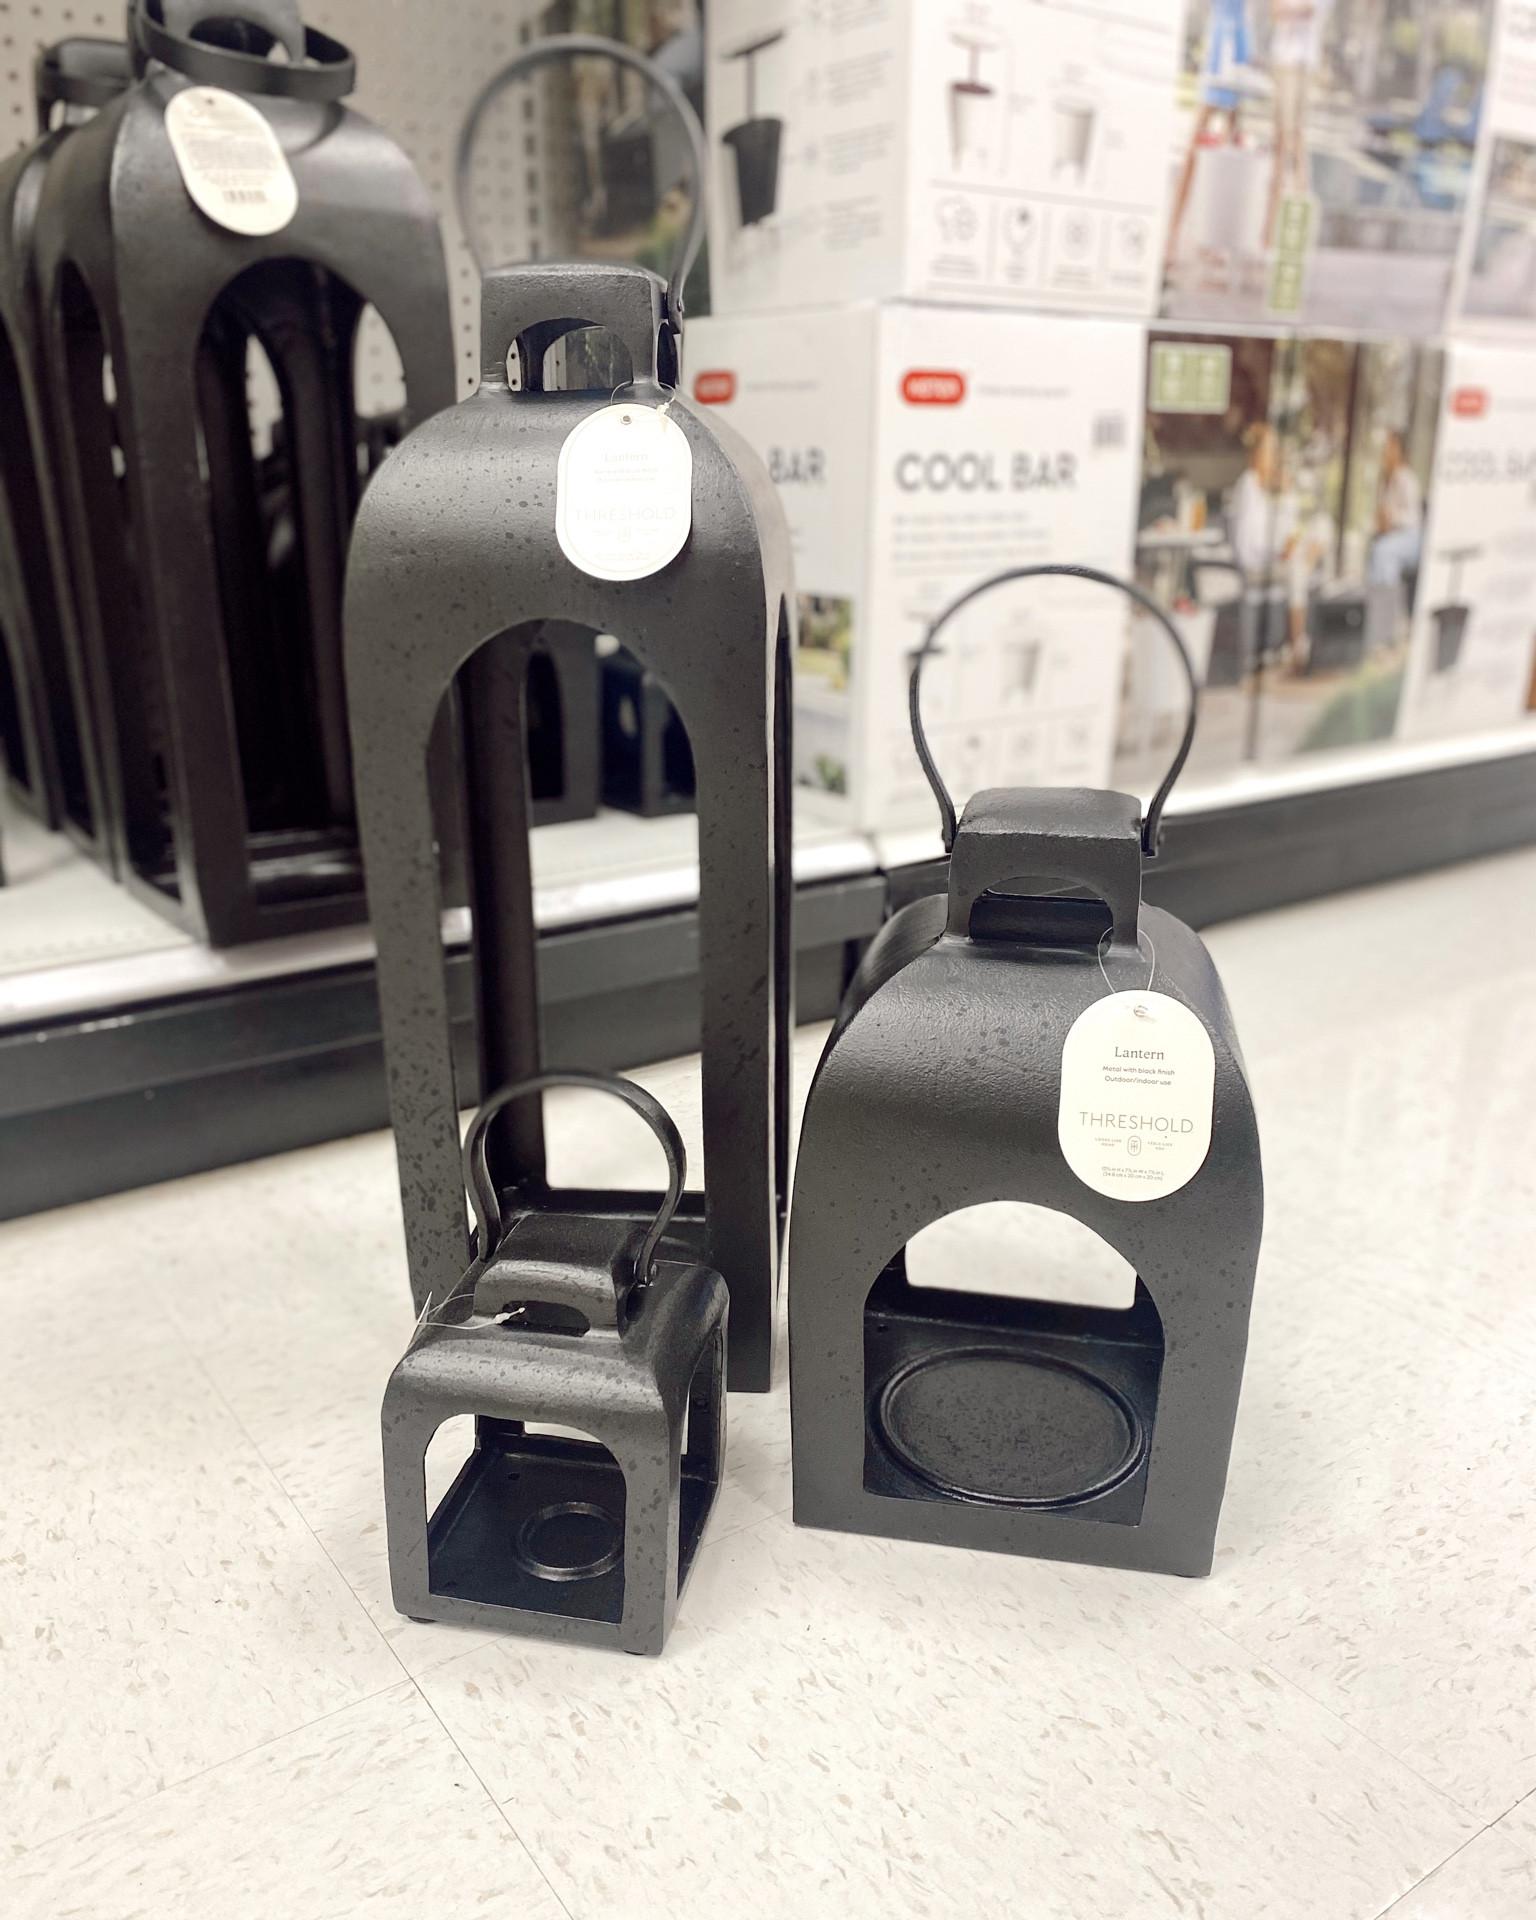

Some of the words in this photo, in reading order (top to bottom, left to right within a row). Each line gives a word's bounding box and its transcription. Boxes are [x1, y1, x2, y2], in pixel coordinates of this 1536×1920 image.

[603, 451, 649, 462] Lantern
[895, 451, 1002, 493] COOL
[1010, 451, 1077, 494] BAR
[574, 507, 676, 521] THRESHOLD
[1115, 1046, 1164, 1060] Lantern
[1158, 1068, 1175, 1076] finish
[1105, 1075, 1159, 1085] Outdoor/indoor
[1080, 1111, 1194, 1134] THRESHOLD
